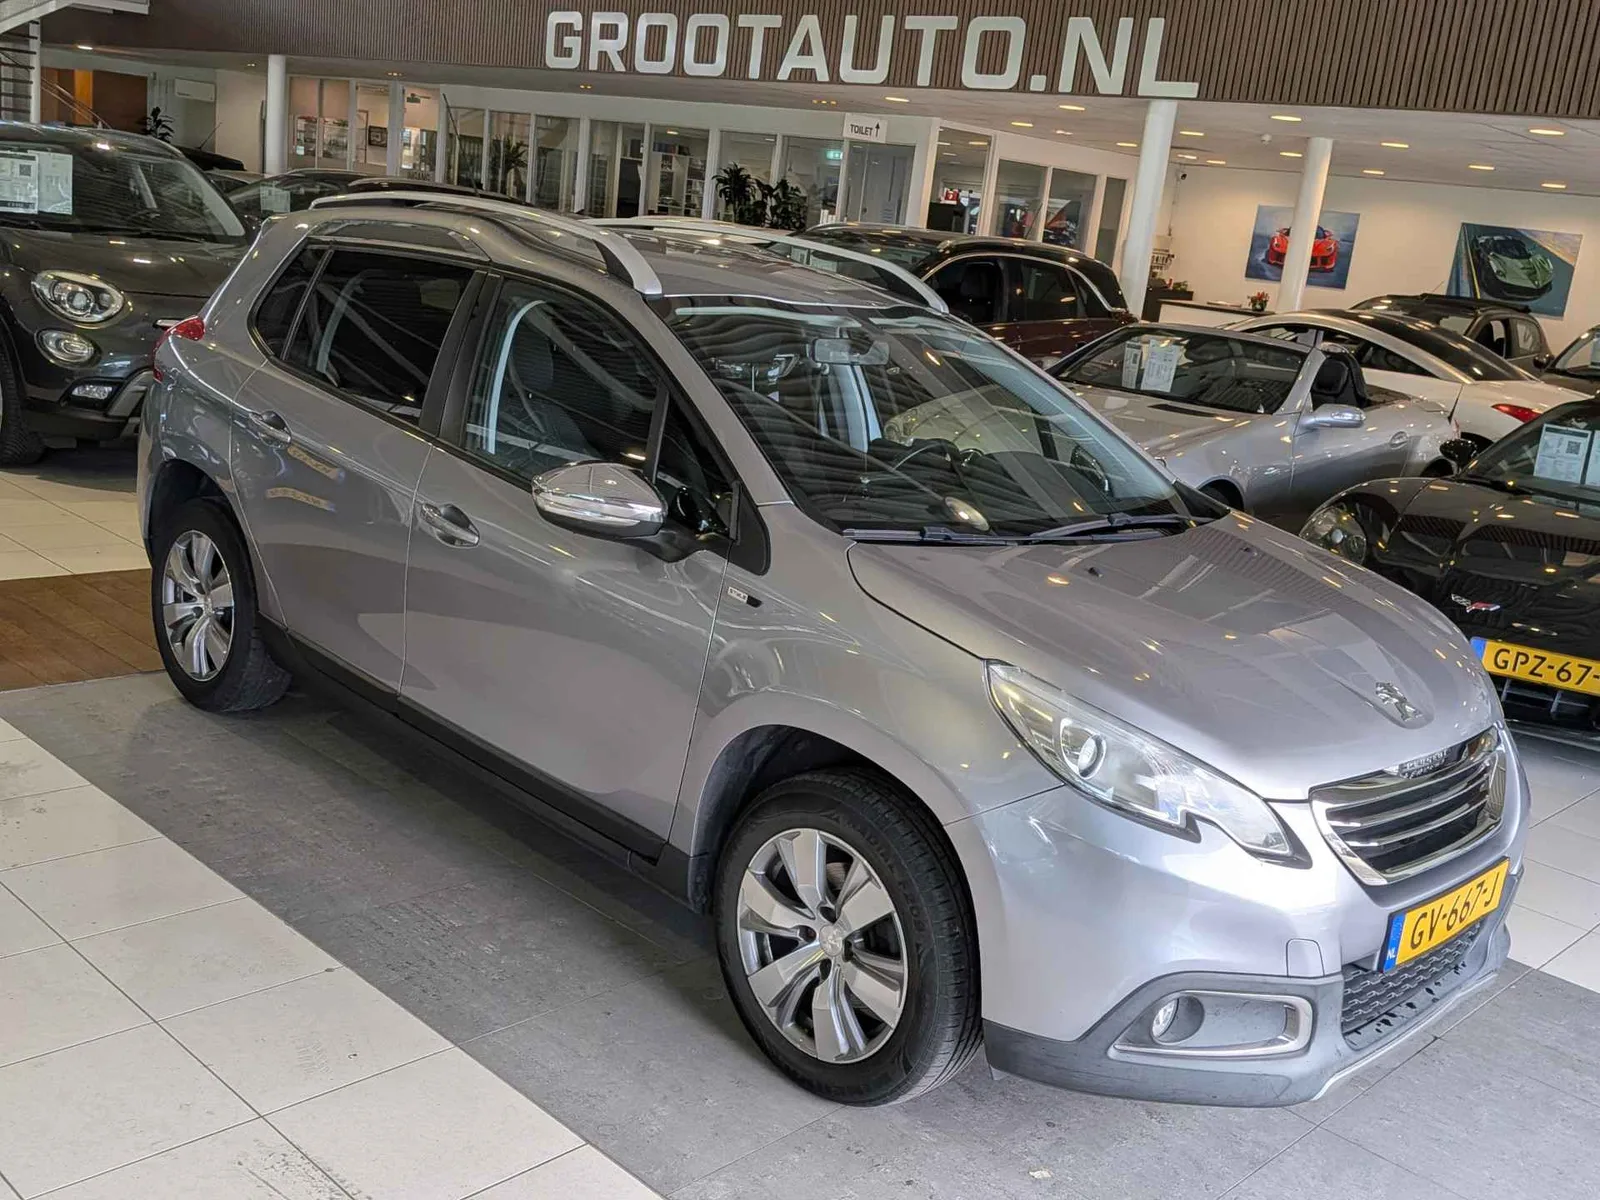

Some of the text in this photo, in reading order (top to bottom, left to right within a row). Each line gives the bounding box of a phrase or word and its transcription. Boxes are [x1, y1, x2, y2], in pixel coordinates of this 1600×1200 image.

[545, 11, 1199, 98] GROOTAUTO.NL
[849, 123, 874, 136] TOILET
[1410, 871, 1500, 950] GV-667-J
[1387, 947, 1397, 959] NL
